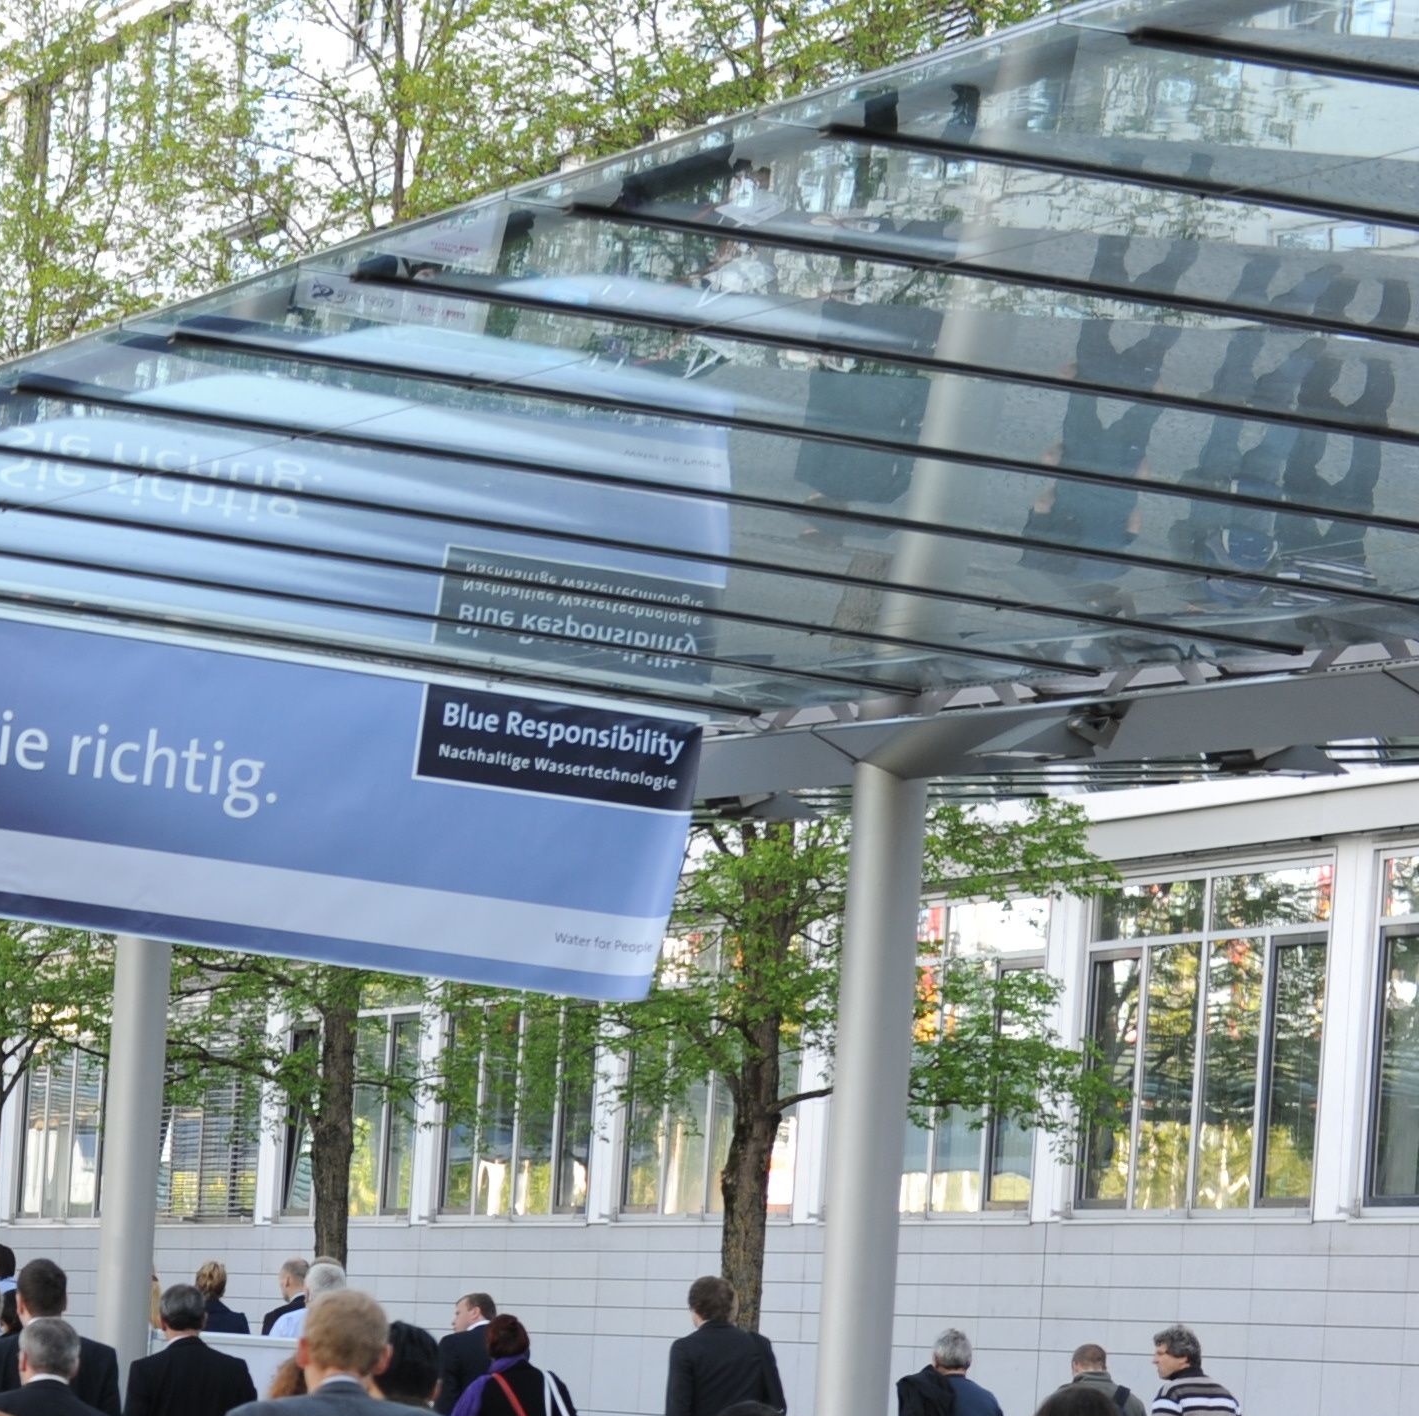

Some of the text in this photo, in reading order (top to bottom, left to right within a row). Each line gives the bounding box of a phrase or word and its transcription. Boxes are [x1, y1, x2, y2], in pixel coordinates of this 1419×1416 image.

[442, 702, 685, 765] Blue Responsibility
[67, 723, 277, 819] richtig.
[438, 743, 678, 792] Nachhaltige Wassertechnologie
[554, 931, 593, 948] Water
[594, 935, 612, 950] for
